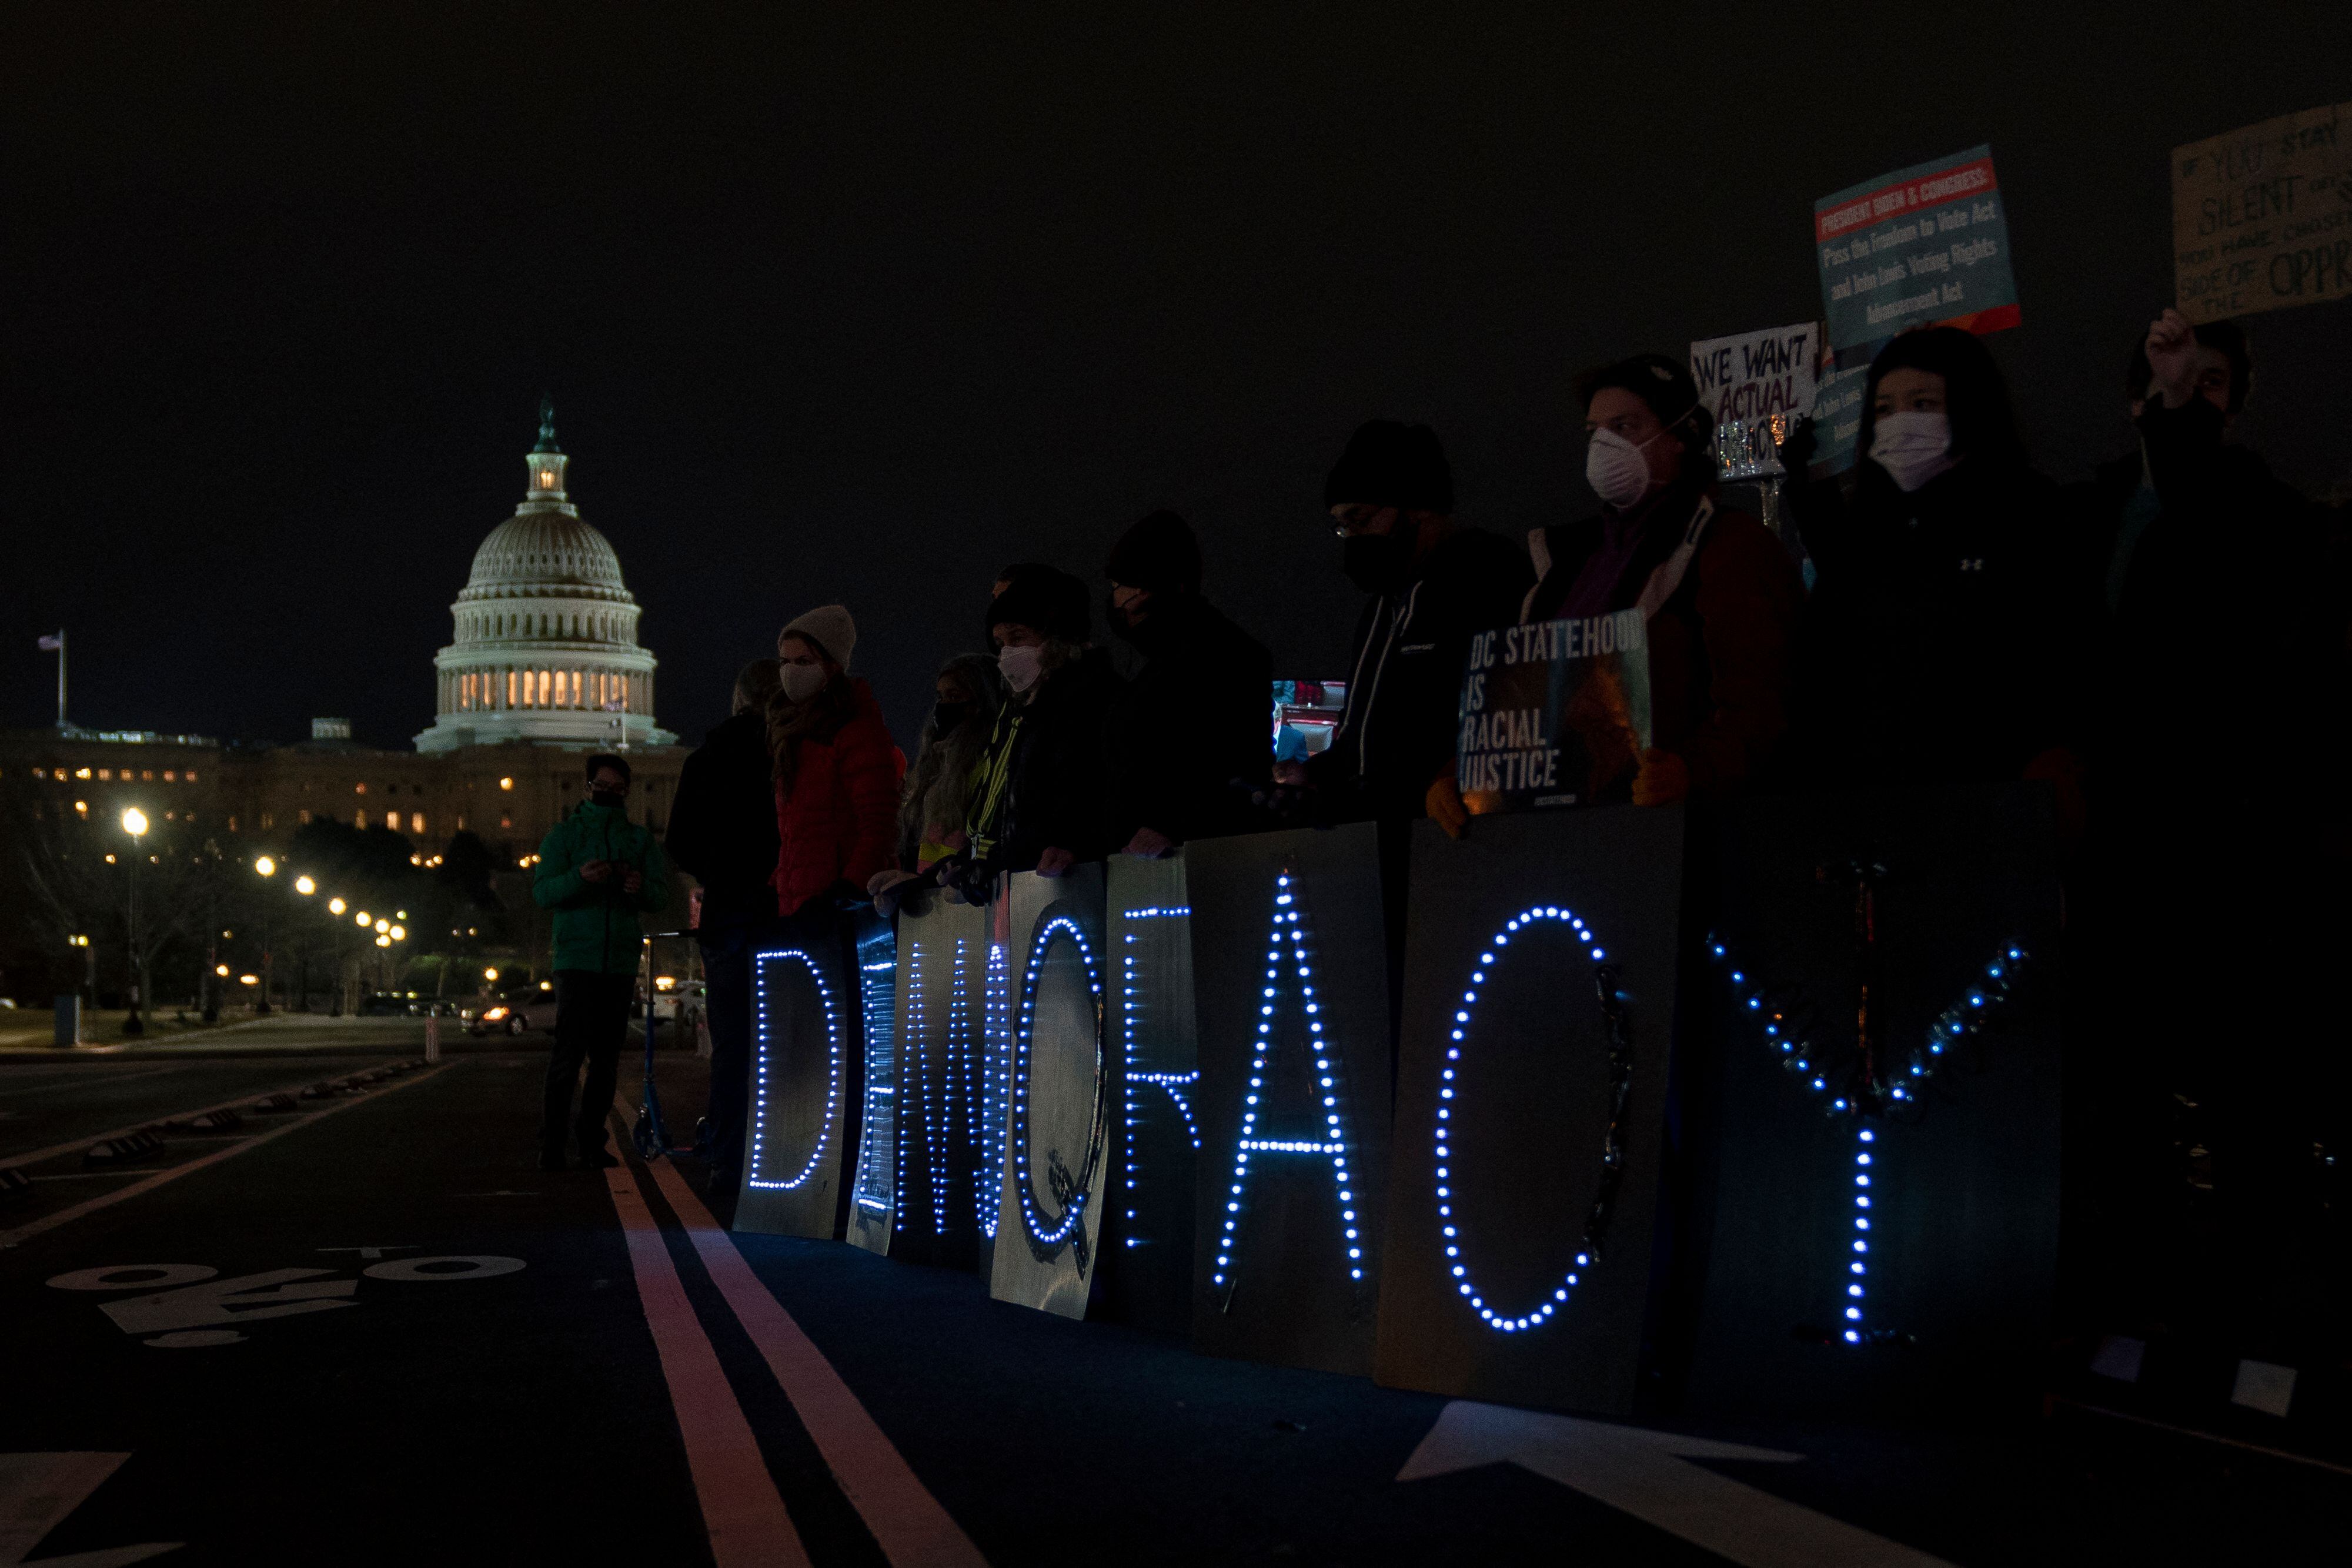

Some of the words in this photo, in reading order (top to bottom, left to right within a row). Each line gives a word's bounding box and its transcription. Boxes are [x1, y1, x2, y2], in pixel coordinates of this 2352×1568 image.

[2281, 118, 2338, 156] STAY
[1823, 200, 1872, 232] PRESIDENT
[1872, 189, 1906, 217] BIDEN
[1907, 186, 1919, 206] &
[2199, 173, 2303, 236] SILENT
[1823, 247, 1850, 268] Pass
[1850, 238, 1870, 260] the
[1870, 225, 1918, 252] Freedom
[1919, 219, 1935, 236] to
[1936, 209, 1970, 233] Vote
[1972, 201, 1996, 225] Act
[2221, 230, 2274, 256] HAVE
[1830, 276, 1852, 301] and
[1852, 272, 1878, 295] John
[1877, 261, 1907, 286] Lewis
[1907, 251, 1950, 276] Voting
[1950, 237, 1997, 266] Rights
[2180, 267, 2223, 301] SIDE
[2227, 258, 2258, 287] OF
[1866, 287, 1940, 325] Advancement
[1942, 280, 1964, 303] Act
[2201, 290, 2245, 315] THE
[1692, 347, 1732, 393] WE
[1743, 333, 1807, 380] WANT
[1717, 375, 1799, 425] ACTUAL
[1470, 630, 1497, 671] DC
[1466, 673, 1486, 712] IS
[1462, 708, 1547, 753] RACIAL
[1459, 748, 1562, 795] JUSTICE
